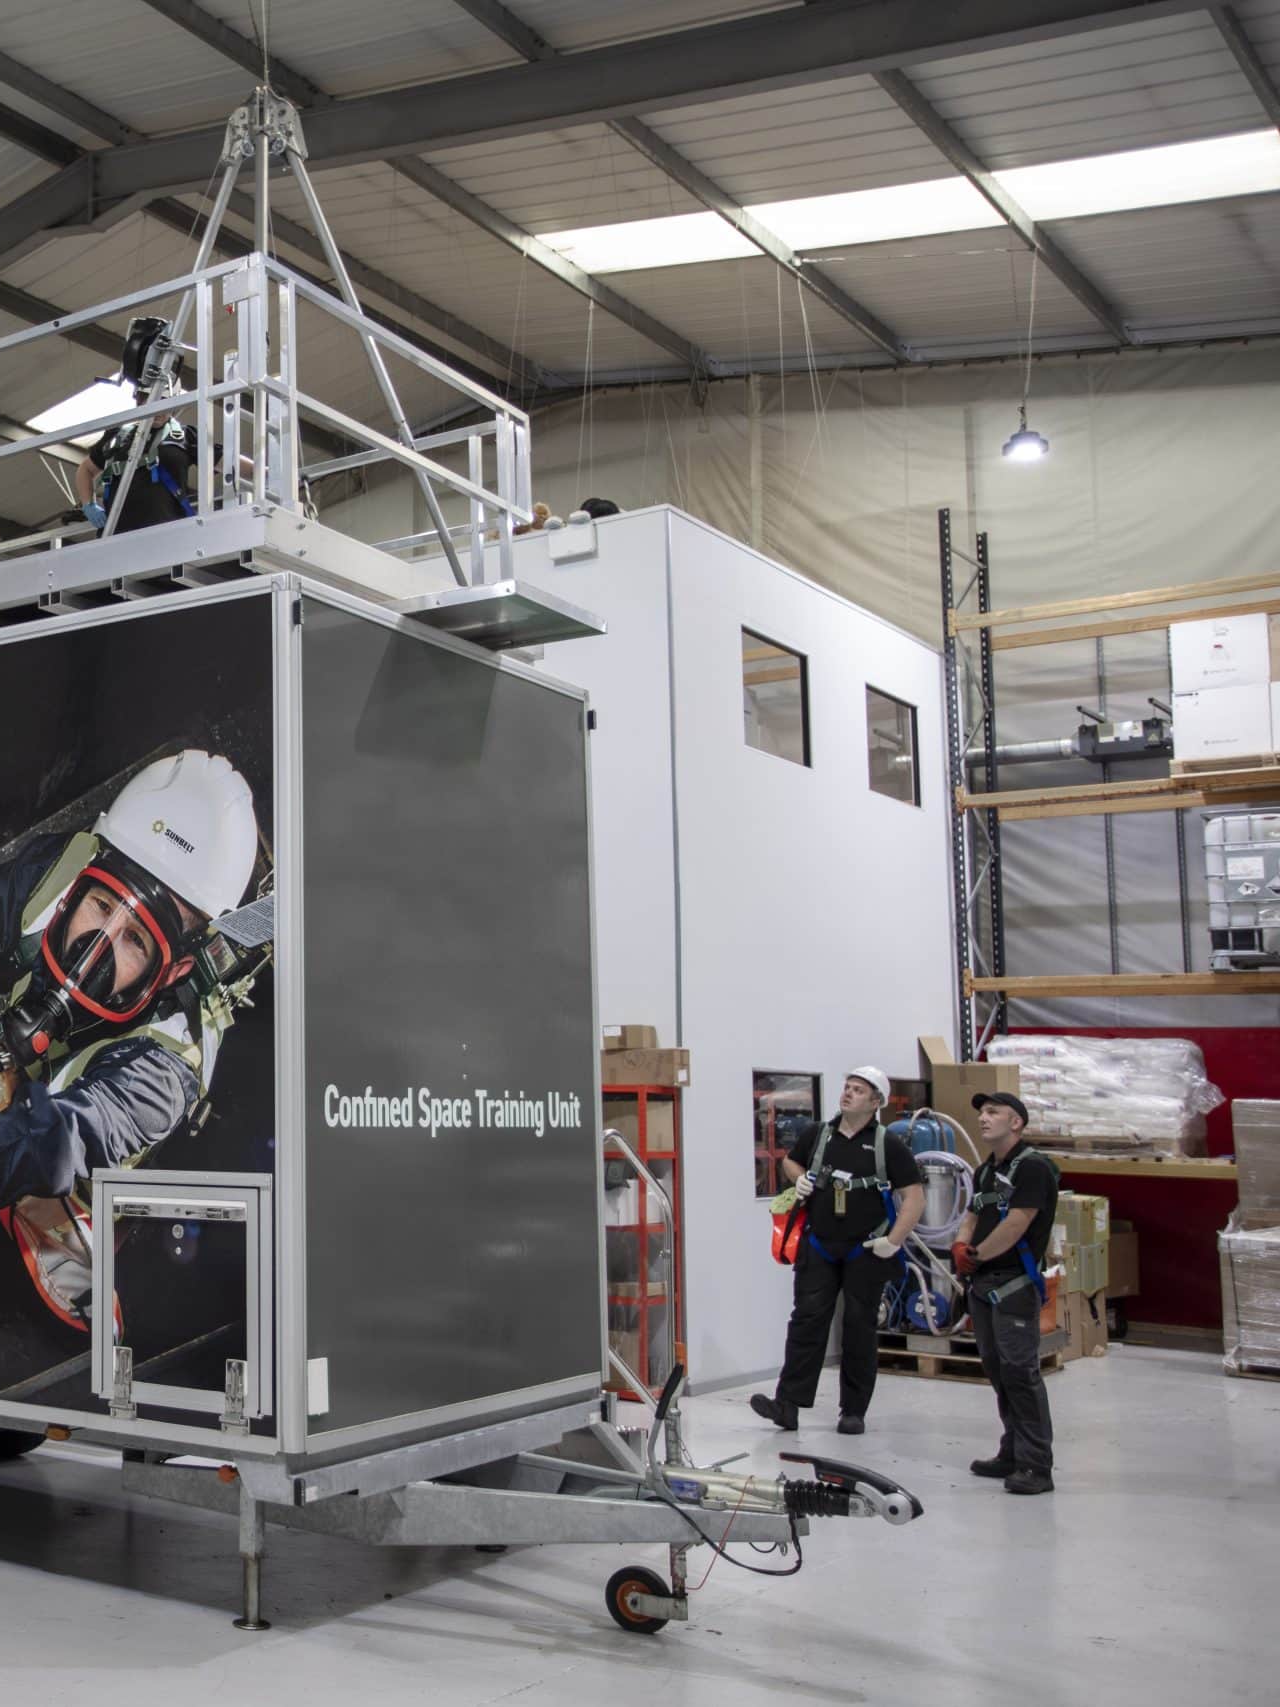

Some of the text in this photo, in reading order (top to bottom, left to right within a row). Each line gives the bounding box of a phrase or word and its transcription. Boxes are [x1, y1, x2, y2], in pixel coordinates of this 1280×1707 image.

[164, 828, 195, 853] SUNBELT
[324, 1083, 582, 1138] Confined Space Training Unit
